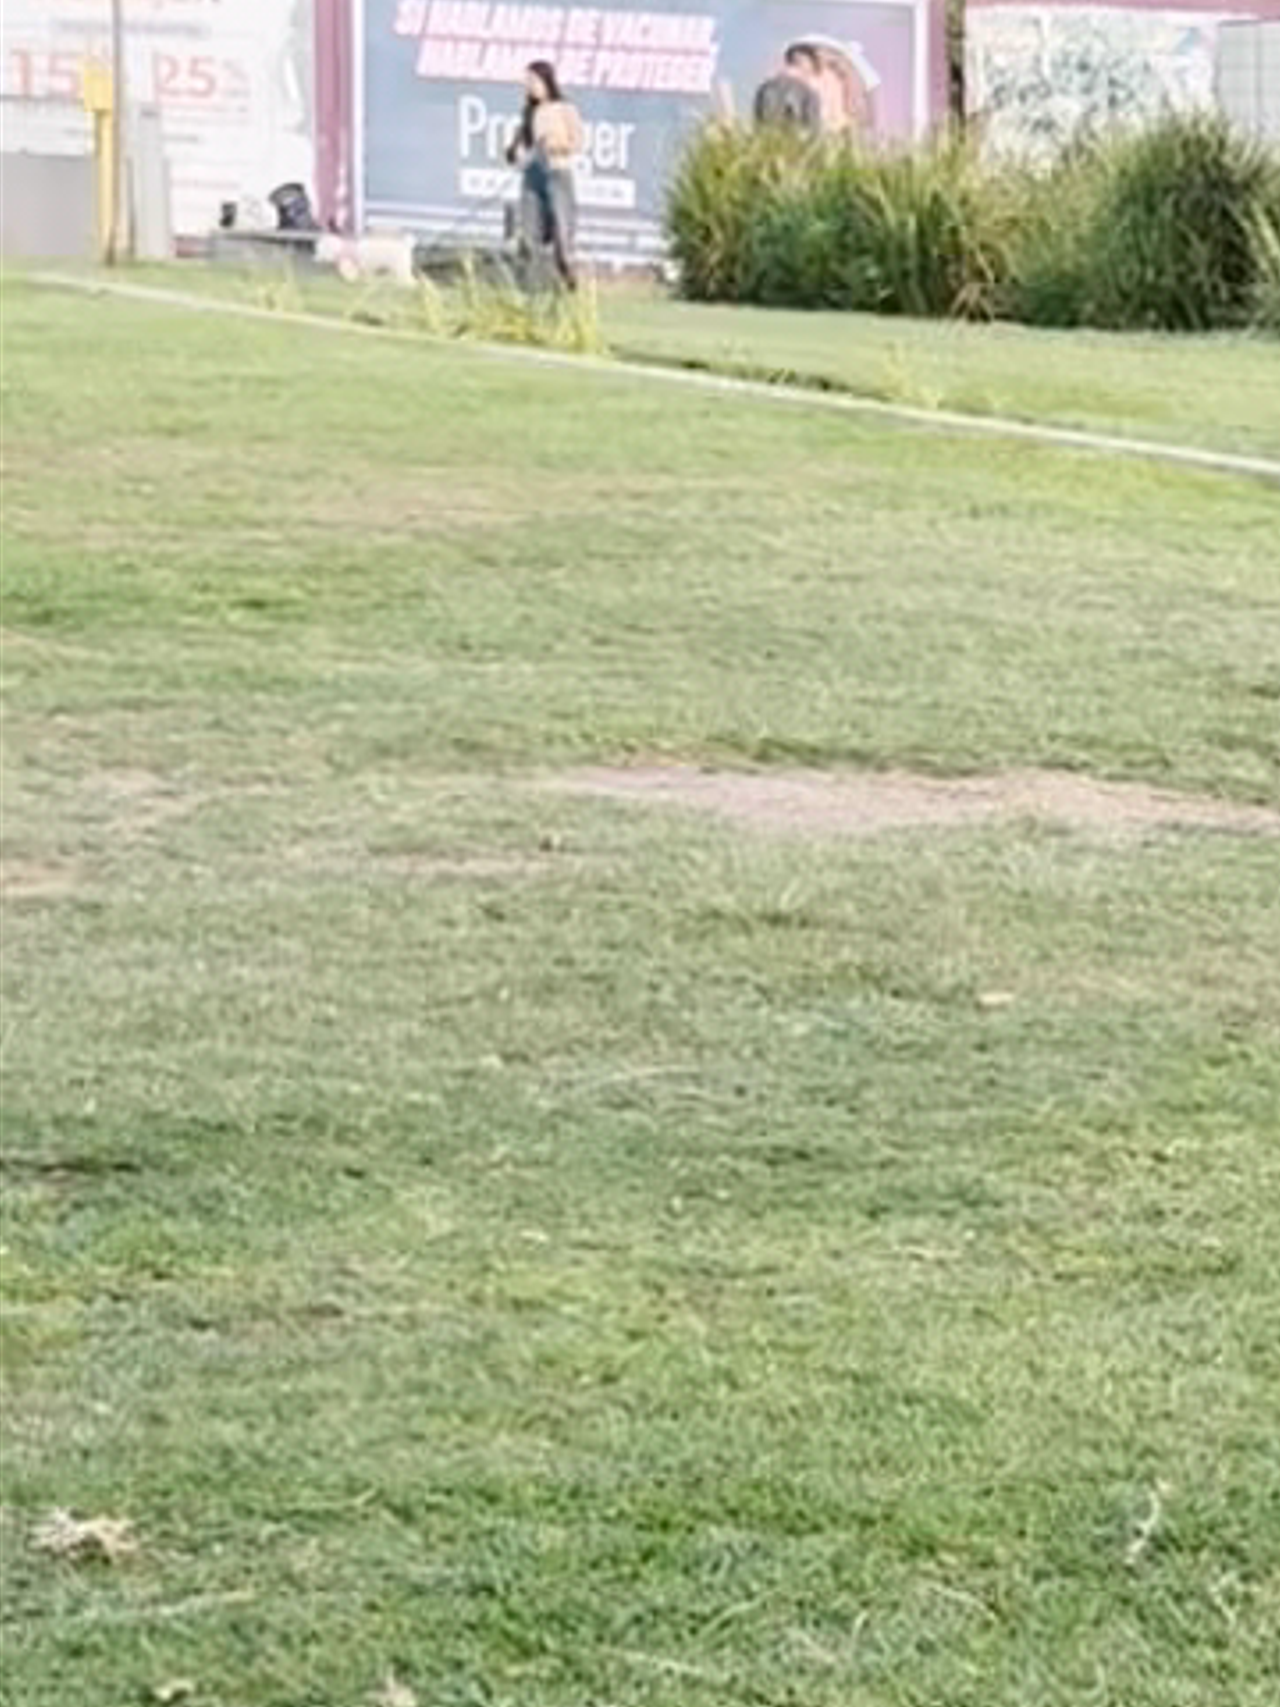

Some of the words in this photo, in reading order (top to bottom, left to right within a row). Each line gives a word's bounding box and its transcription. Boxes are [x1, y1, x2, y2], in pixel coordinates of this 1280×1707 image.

[564, 7, 601, 46] DE
[557, 45, 596, 85] DE
[591, 48, 714, 92] PROTEGER
[459, 94, 636, 179] Proger
